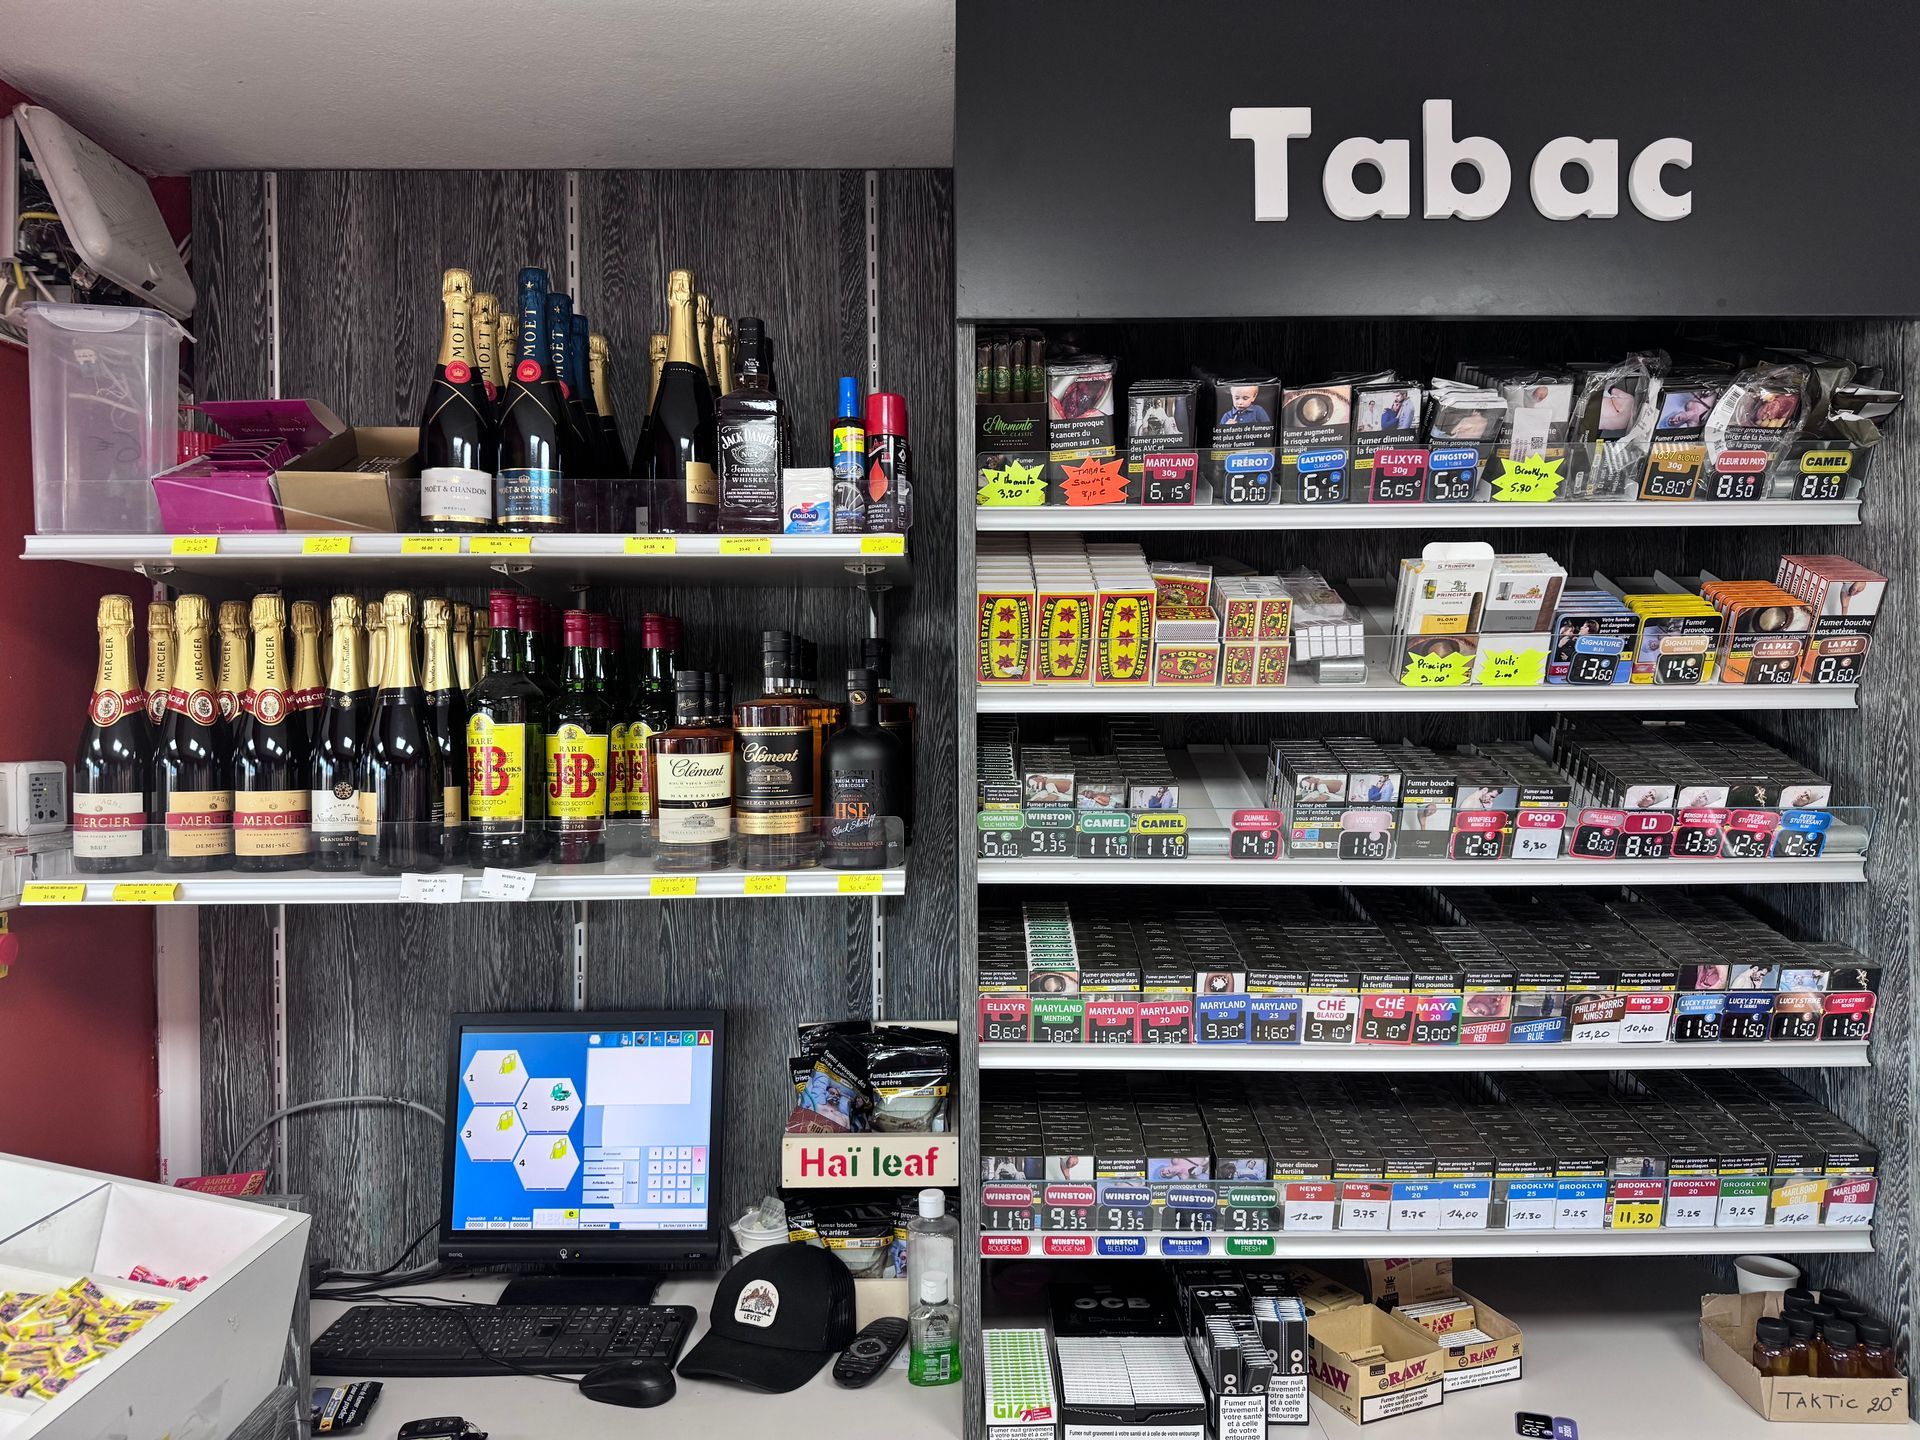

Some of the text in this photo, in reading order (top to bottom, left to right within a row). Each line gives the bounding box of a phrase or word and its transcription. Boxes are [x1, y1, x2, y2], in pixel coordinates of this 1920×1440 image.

[1230, 99, 1693, 221] Tabac
[450, 309, 464, 358] MOËT
[522, 307, 537, 357] MOËT
[722, 434, 744, 449] JACK
[1357, 435, 1414, 445] Fumer diminue
[1051, 441, 1077, 450] poumon
[1301, 453, 1343, 464] EASTWOOD
[1380, 455, 1423, 464] ELIXYR
[1433, 452, 1475, 461] KINGSTON
[1146, 458, 1194, 468] MARYLAND
[1231, 456, 1268, 467] FRÉROT
[1719, 457, 1765, 466] FLEUR DU PAYS
[1806, 457, 1847, 467] CAMEL
[731, 464, 769, 473] Tennessee
[1392, 467, 1408, 475] 30g
[1162, 470, 1177, 478] 30g
[1819, 618, 1871, 627] Fumer bouche
[1684, 626, 1714, 634] provoque
[1100, 602, 1114, 676] THREE STARS
[1135, 599, 1149, 676] SAFETY MATCHES
[1581, 638, 1622, 648] SIGNATURE
[1665, 639, 1706, 647] SIGNATURE
[1827, 640, 1841, 648] LA
[104, 637, 113, 681] MERCIER
[157, 640, 166, 682] MERCIER
[193, 637, 204, 681] MERCIER
[223, 640, 231, 682] MERCIER
[267, 636, 275, 680] MERCIER
[741, 742, 798, 763] Clément
[669, 758, 724, 778] Clément
[835, 803, 870, 820] HSE
[1028, 813, 1071, 821] WINSTON
[1528, 814, 1555, 822] POOL
[1084, 818, 1126, 827] CAMEL
[1141, 819, 1183, 828] CAMEL
[1642, 818, 1658, 829] LD
[1200, 1000, 1246, 1010] MARYLAND
[1252, 1002, 1298, 1011] MARYLAND
[1317, 998, 1346, 1010] CHÉ
[1376, 997, 1405, 1010] CHÉ
[1417, 1003, 1457, 1011] MAYA
[1574, 999, 1624, 1014] PHILIP MORRIS
[1034, 1004, 1082, 1013] MARYLAND
[1089, 1007, 1135, 1015] MARYLAND
[1141, 1006, 1189, 1015] MARYLAND
[1583, 1012, 1603, 1021] KINGS
[1514, 1021, 1561, 1033] CHESTERFIELD
[1474, 1033, 1486, 1042] RED
[1527, 1031, 1544, 1041] BLUE
[522, 1102, 528, 1110] 2
[519, 1159, 526, 1167] 4
[801, 1147, 939, 1177] Haï leaf
[1510, 1182, 1554, 1190] BROOKLYN
[1559, 1182, 1603, 1190] BROOKLYN
[1833, 1183, 1870, 1197] MARLBORO
[986, 1192, 1031, 1200] WINSTON
[1048, 1191, 1093, 1200] WINSTON
[1105, 1193, 1150, 1201] WINSTON
[1170, 1194, 1214, 1203] WINSTON
[1231, 1194, 1276, 1202] WINSTON
[1844, 1194, 1856, 1203] RED
[1470, 1346, 1499, 1364] RAW
[1389, 1359, 1427, 1387] RAW
